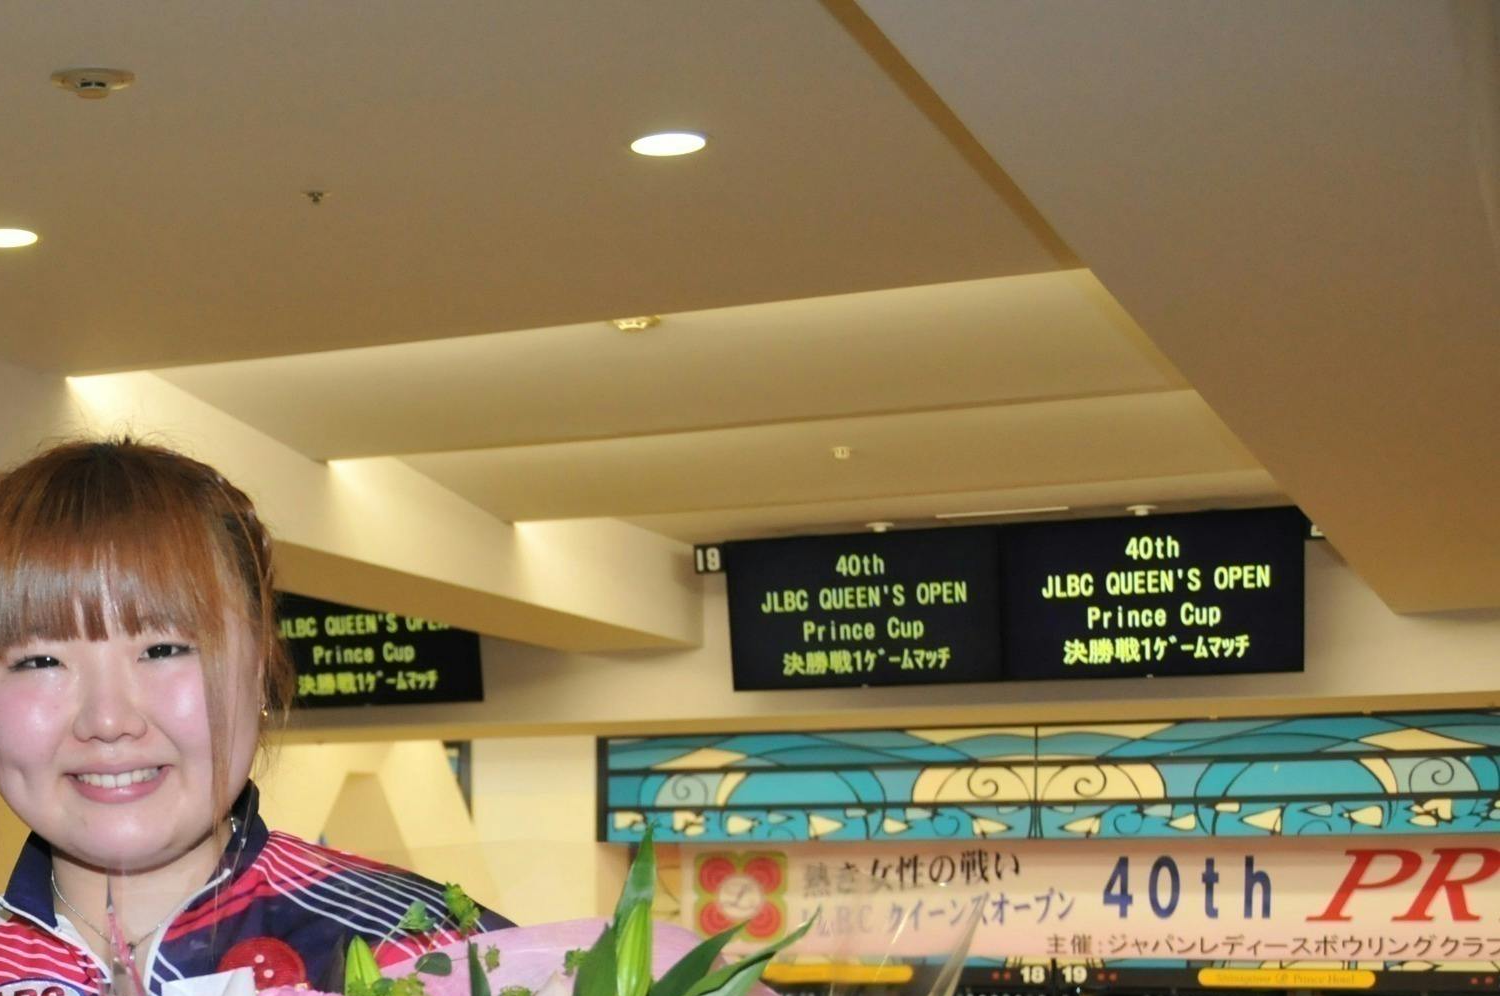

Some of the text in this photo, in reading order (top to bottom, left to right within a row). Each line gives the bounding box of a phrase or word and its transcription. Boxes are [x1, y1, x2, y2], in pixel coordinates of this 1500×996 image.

[696, 547, 721, 572] 19
[1125, 535, 1180, 560] 40th
[835, 553, 885, 577] 40th
[1042, 564, 1271, 599] JLBC QUEEN'S OPEN
[761, 581, 968, 613] JLBC QUEEN'S OPEN
[324, 613, 398, 637] QUEEN'S
[1087, 602, 1221, 630] Prince Cup
[803, 616, 924, 642] Prince Cup
[313, 642, 416, 666] Prince Cup
[1102, 854, 1272, 920] 40th
[1305, 847, 1500, 922] PR
[1020, 966, 1046, 983] 18
[1062, 965, 1088, 983] 19
